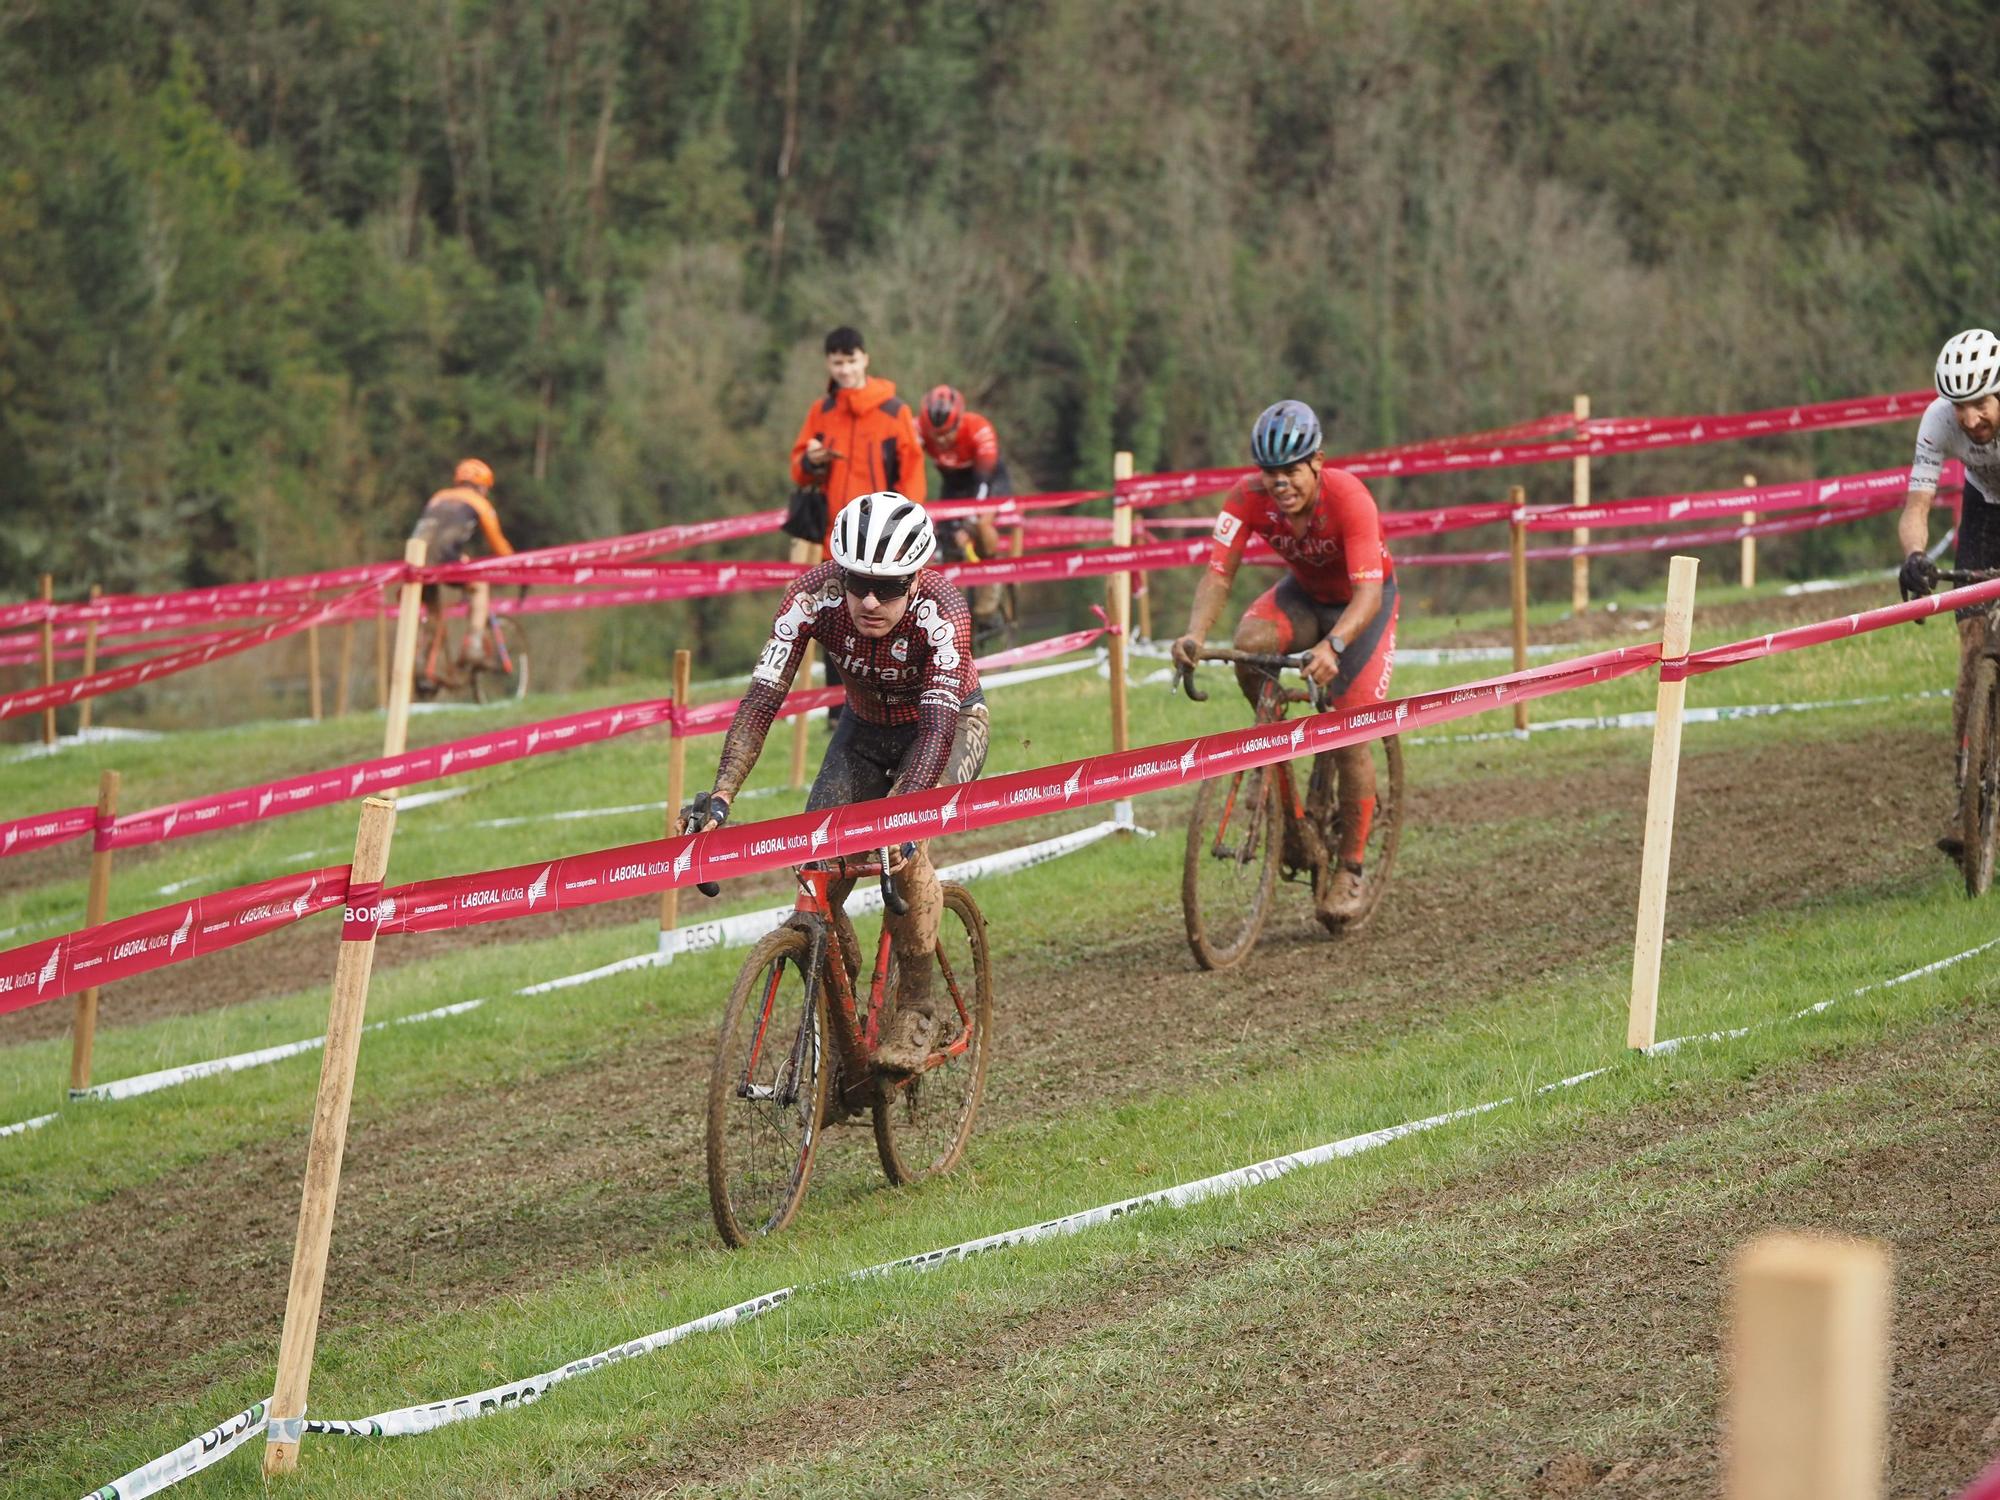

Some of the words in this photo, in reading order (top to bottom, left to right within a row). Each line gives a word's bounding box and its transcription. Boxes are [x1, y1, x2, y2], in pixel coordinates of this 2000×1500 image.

[1220, 518, 1233, 536] 9
[1349, 712, 1376, 729] LABORAL
[1378, 710, 1392, 722] kutxa
[1242, 736, 1272, 754] LABORAL
[1128, 761, 1160, 779] LABORAL
[1160, 759, 1178, 772] kutxa
[1010, 786, 1042, 803] LABORAL
[1042, 784, 1060, 798] kutxa
[884, 812, 918, 830] LABORAL
[918, 808, 938, 824] kutxa
[750, 836, 786, 856] LABORAL
[787, 834, 808, 850] kutxa
[609, 862, 647, 882] LABORAL
[648, 860, 670, 876] kutxa
[461, 889, 500, 908] LABORAL
[502, 887, 524, 902] kutxa
[113, 938, 148, 960] LABORAL
[148, 934, 169, 950] kutxa
[14, 971, 37, 989] kutxa
